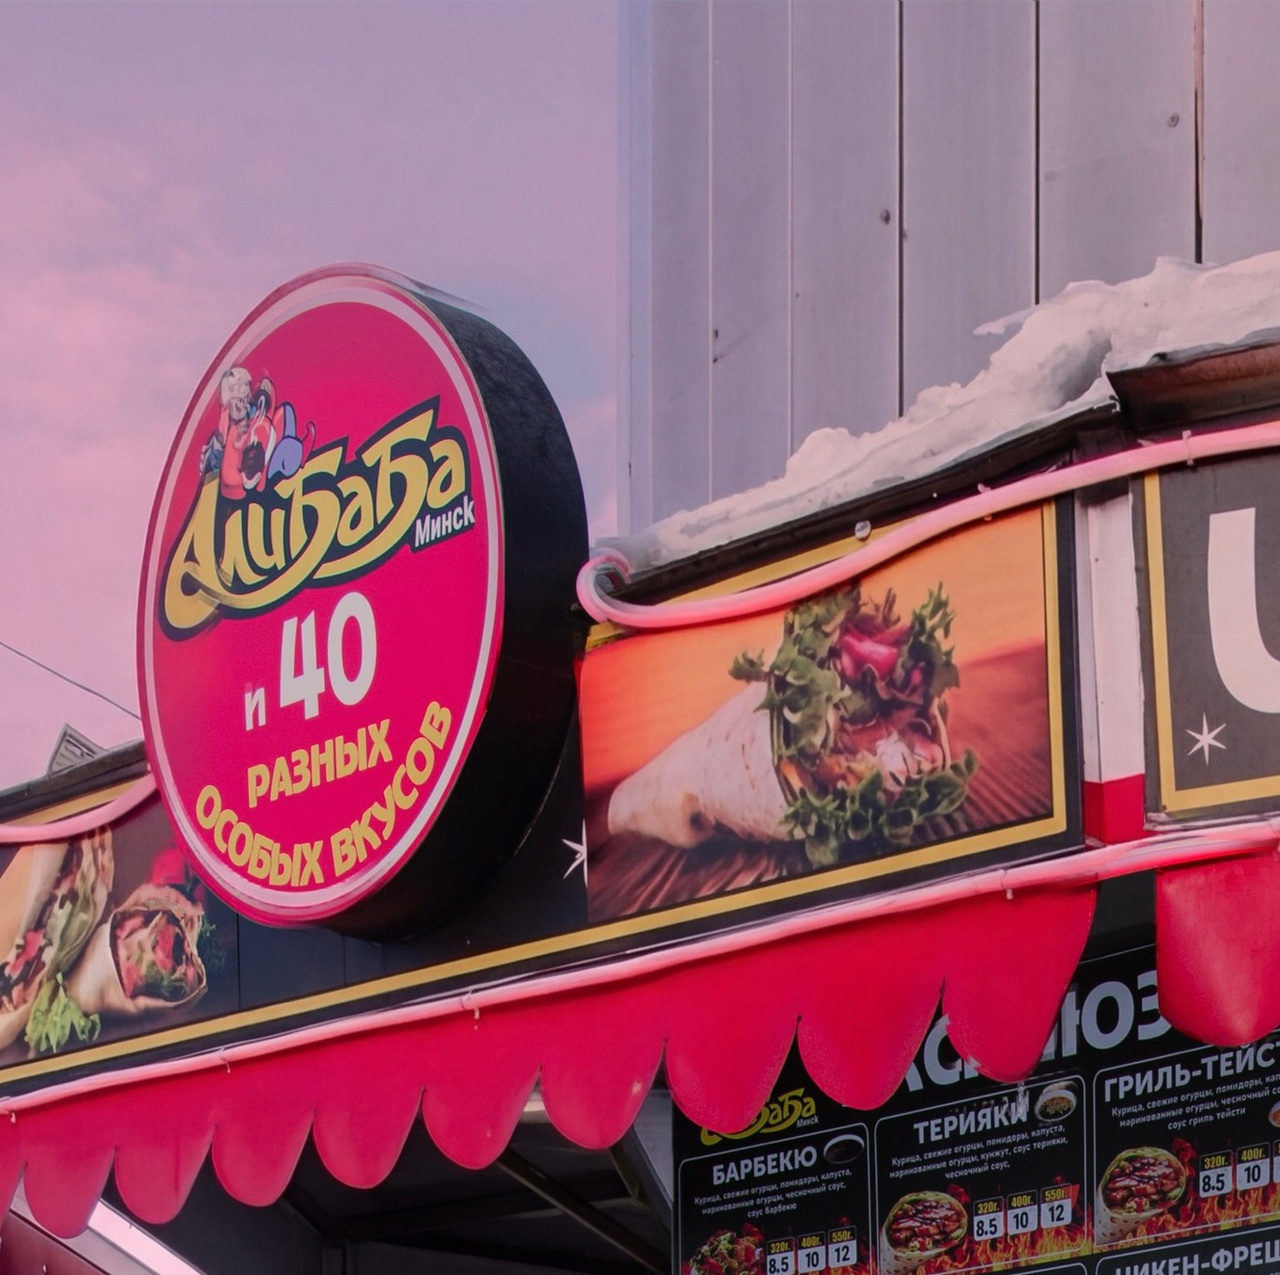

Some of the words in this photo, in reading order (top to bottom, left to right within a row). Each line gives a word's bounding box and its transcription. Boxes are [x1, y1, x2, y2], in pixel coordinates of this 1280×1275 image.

[414, 496, 477, 549] Минск
[279, 591, 378, 719] 40
[247, 719, 393, 808] РАЗНЫХ
[196, 785, 325, 887] ОСОБЫХ
[332, 700, 453, 880] ВКУСОВ
[913, 1095, 1029, 1144] ТЕРИЯКИ
[712, 1145, 817, 1185] БАРБЕКЮ
[1201, 1174, 1225, 1193] 8.5
[1243, 1162, 1261, 1182] 10
